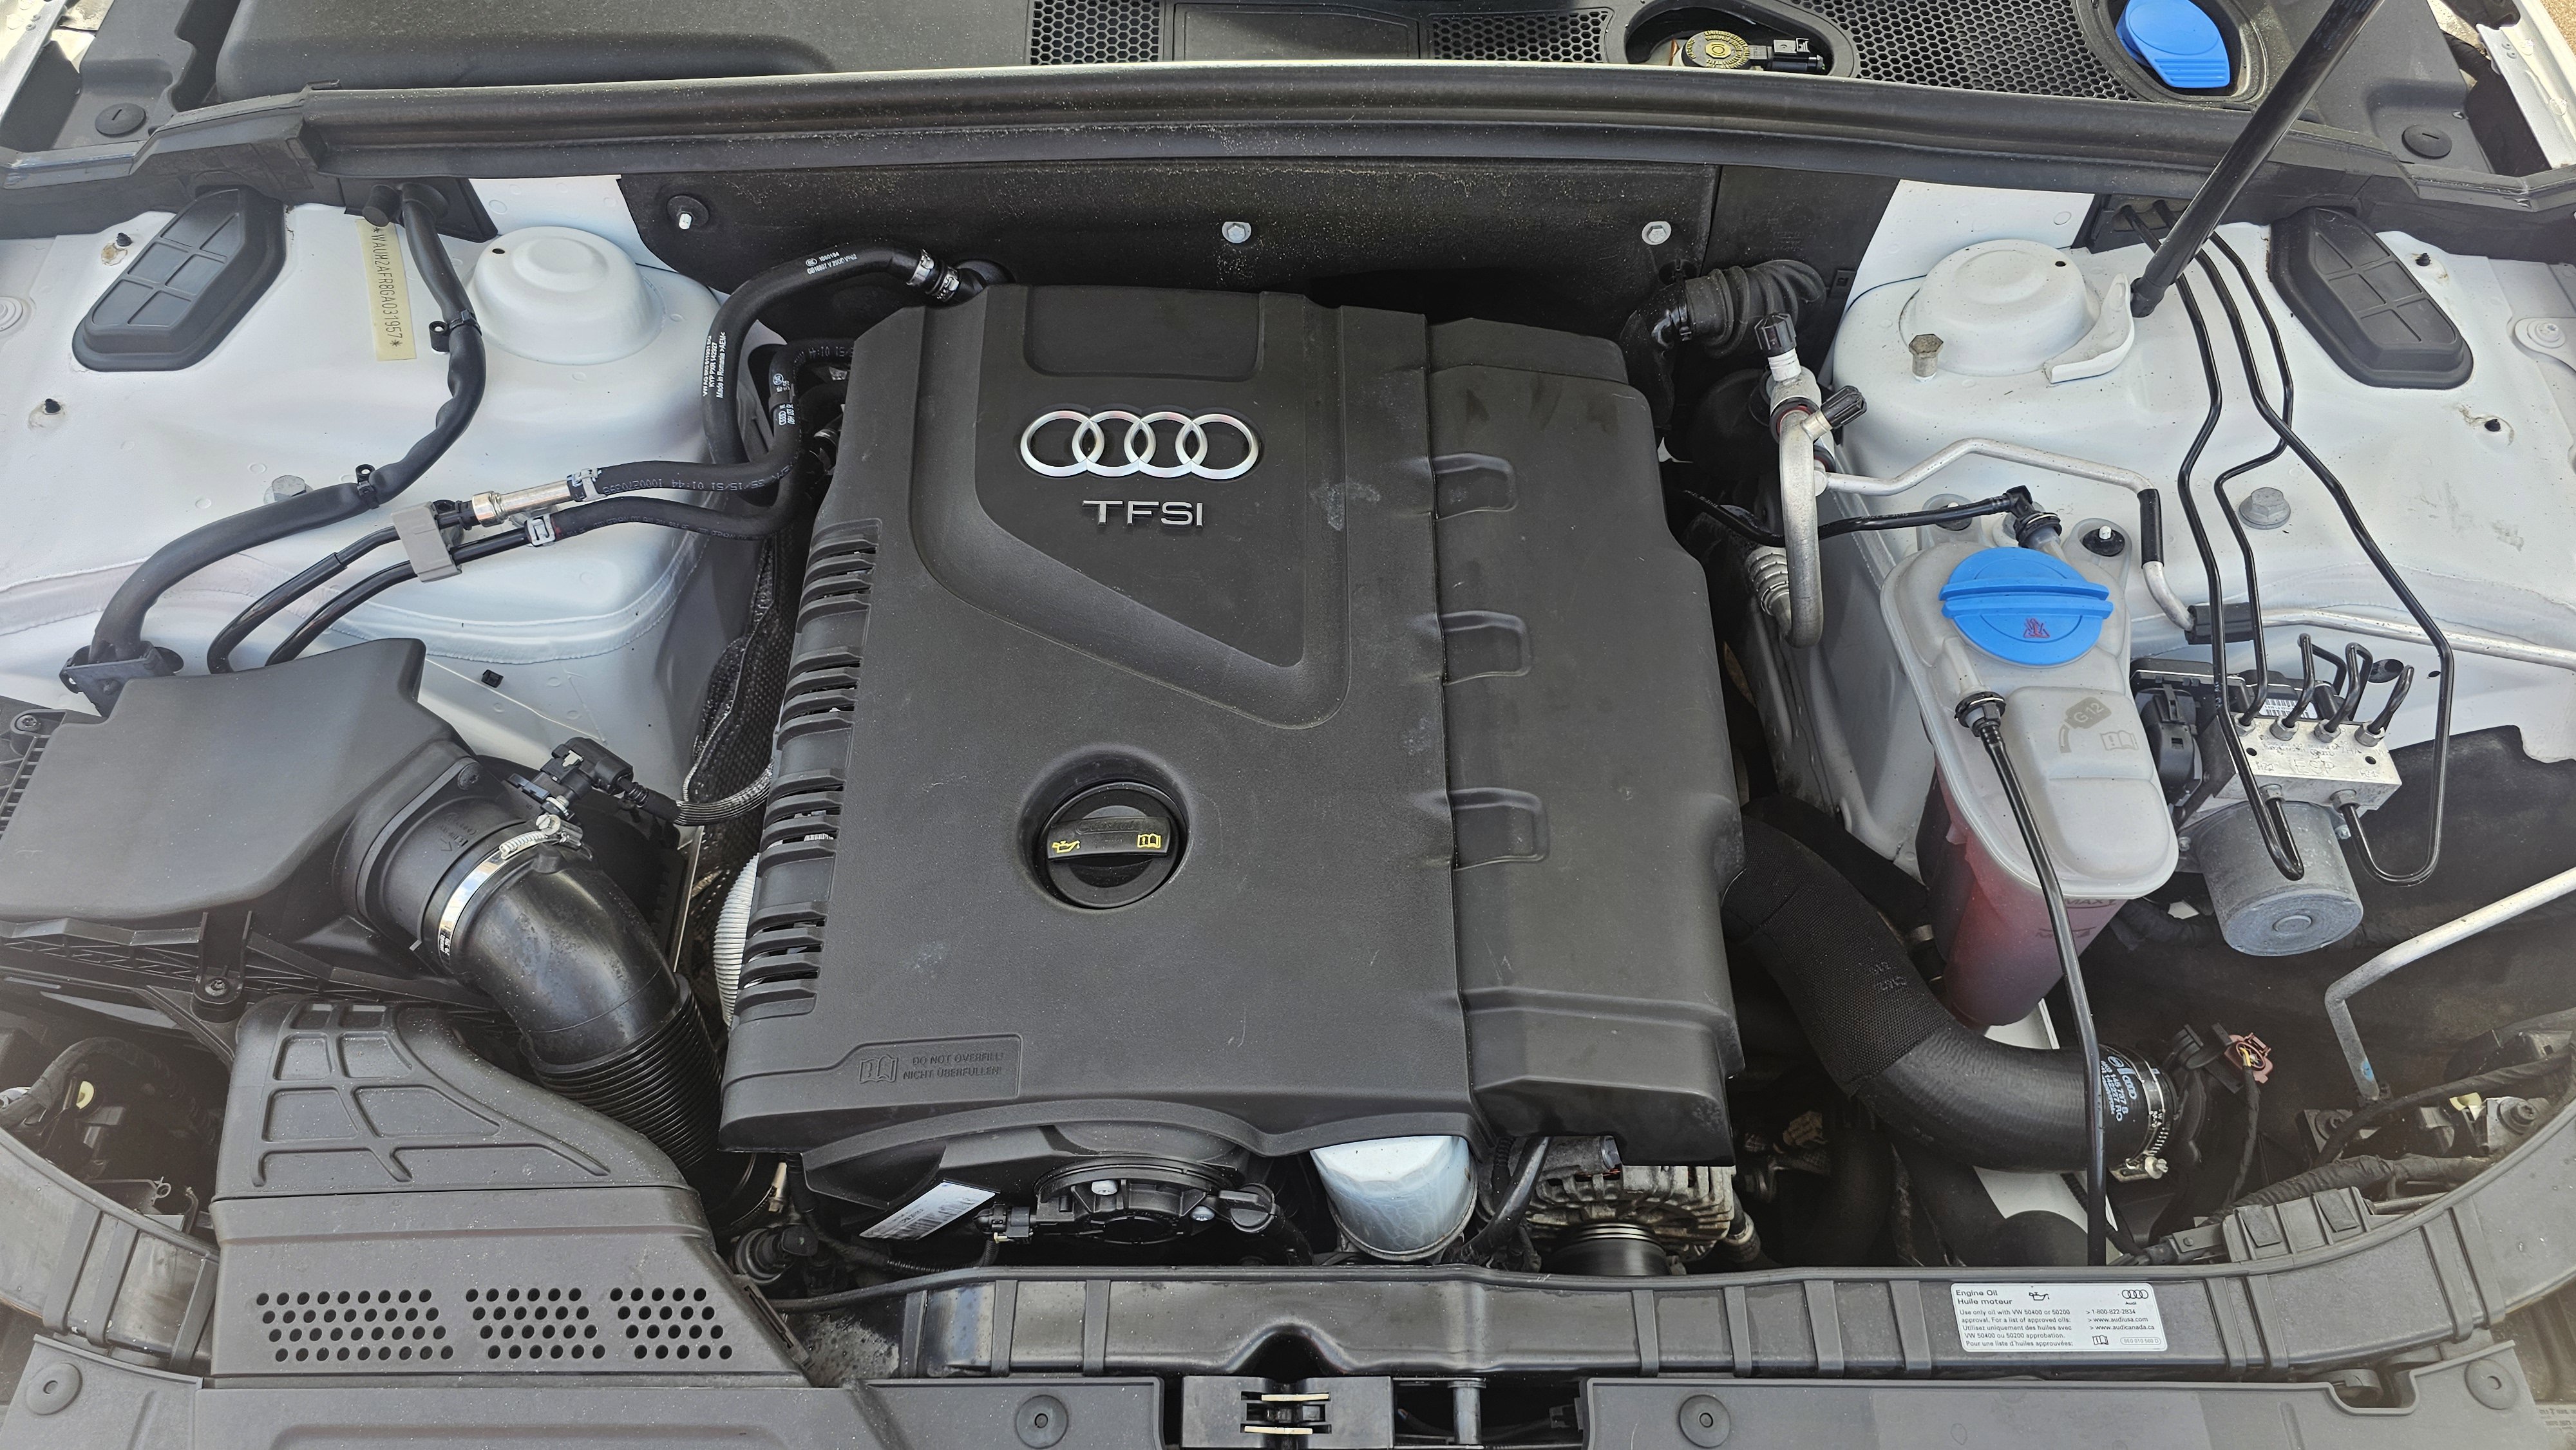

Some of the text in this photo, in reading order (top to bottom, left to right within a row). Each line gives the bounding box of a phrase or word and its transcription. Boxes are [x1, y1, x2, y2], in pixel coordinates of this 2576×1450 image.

[717, 353, 725, 376] Romania
[1082, 500, 1203, 528] TFSI
[2293, 758, 2335, 775] ESP
[913, 1055, 927, 1065] DO
[931, 1054, 952, 1064] NOT
[903, 1069, 934, 1080] NICHT
